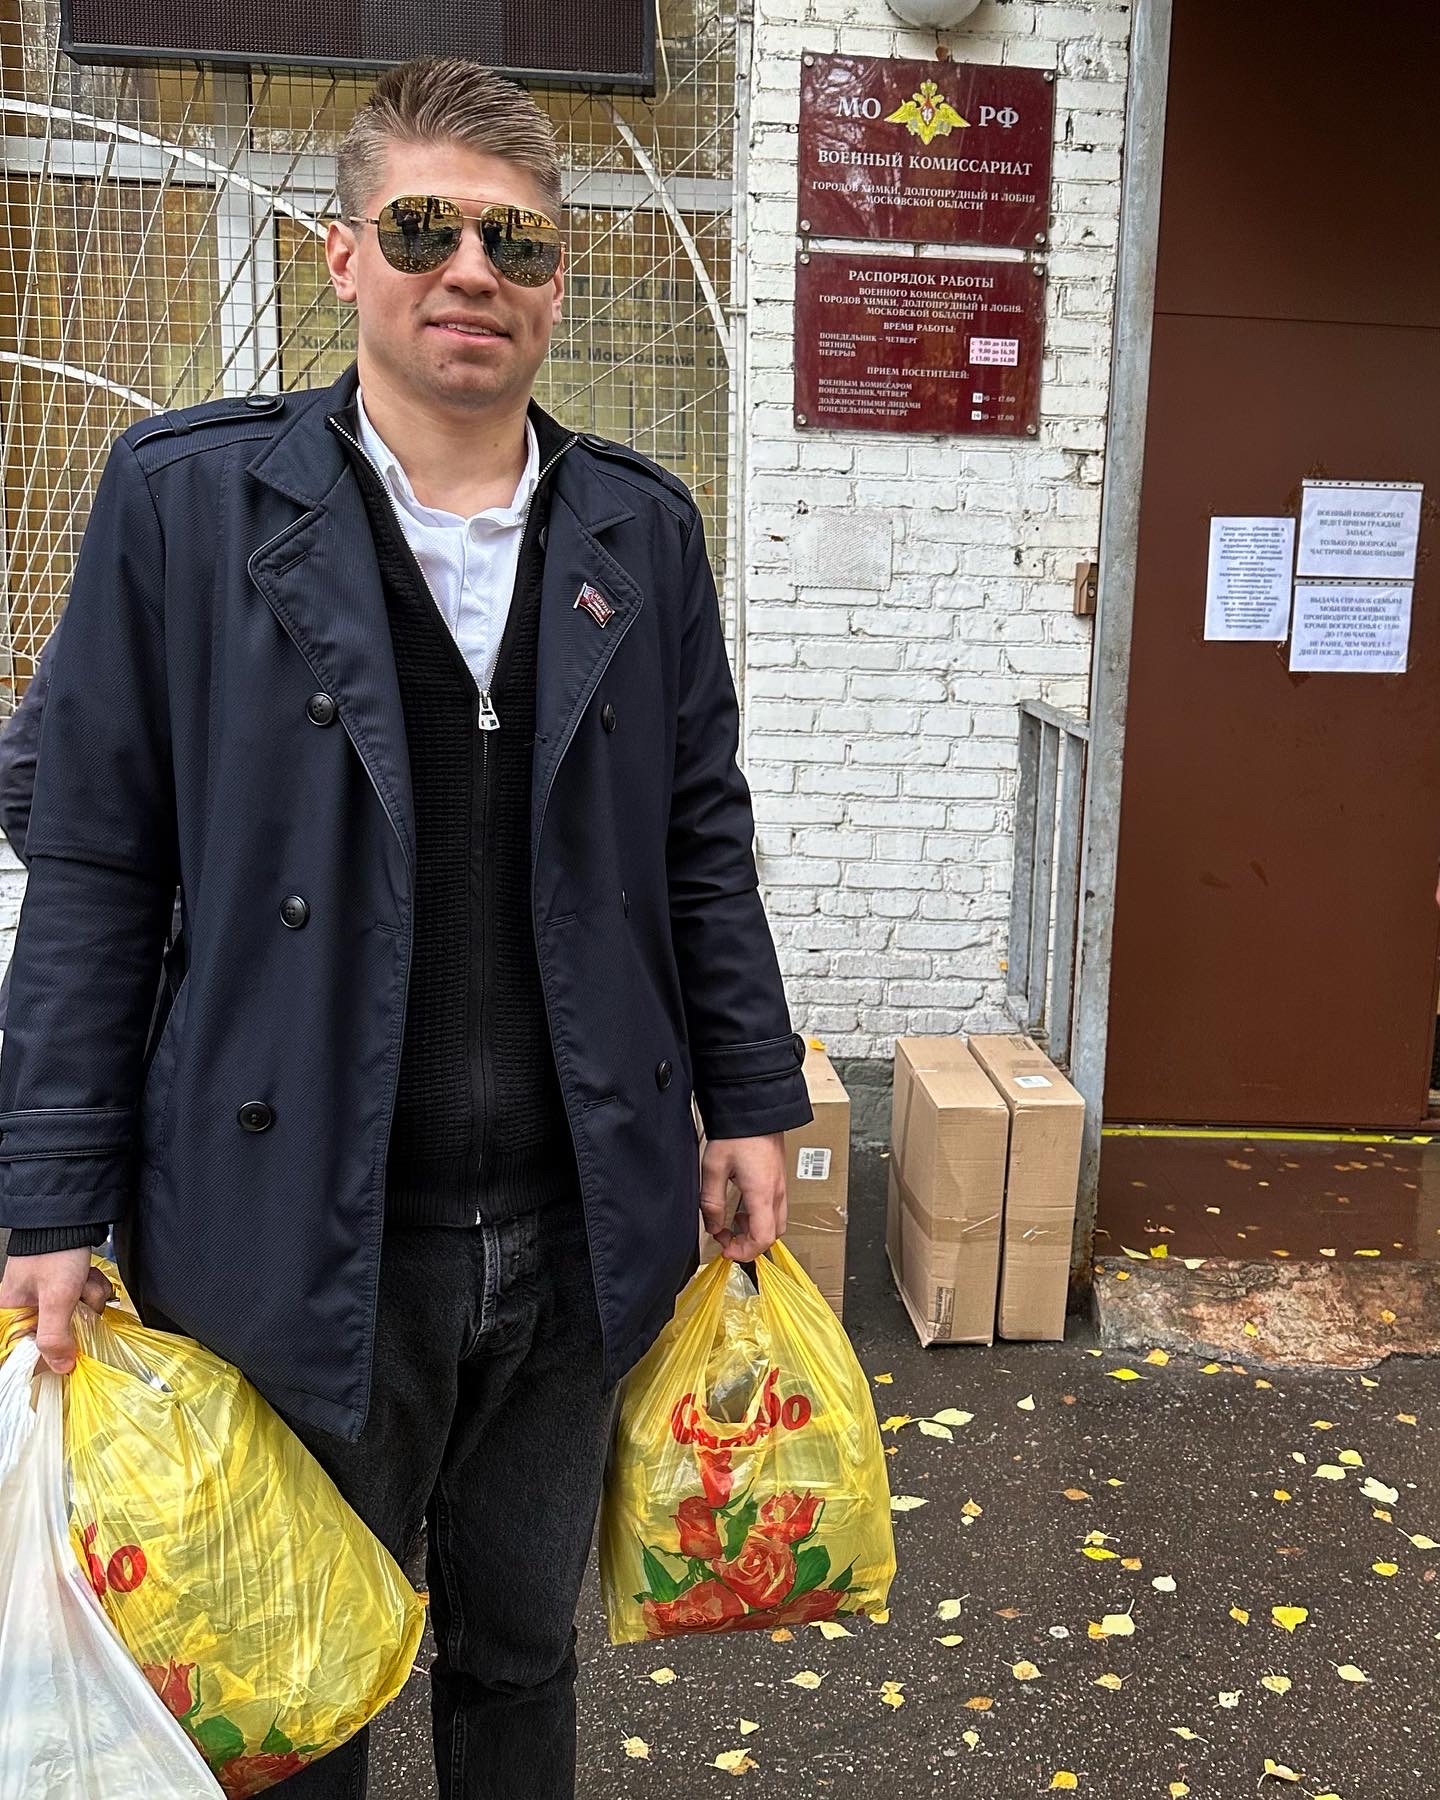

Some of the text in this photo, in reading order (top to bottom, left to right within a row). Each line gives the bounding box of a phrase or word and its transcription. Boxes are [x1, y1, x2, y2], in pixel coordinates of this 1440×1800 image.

[836, 96, 1019, 128] МО РФ
[818, 149, 1032, 176] ВОЕННЫЙ КОМИССАРИАТ
[813, 181, 858, 192] ГОРОДОВ
[904, 186, 988, 200] ДОЛГОПРУДНЫЙ
[991, 192, 998, 201] И
[1001, 193, 1035, 203] ЛОБНЯ
[865, 195, 984, 210] МОСКОВСКОЙ ОБЛАСТИ
[848, 270, 994, 288] РАСПОРЯДОК РАБОТЫ
[859, 287, 983, 302] ВОЕННОГО КОМИССАРИАТА
[819, 295, 861, 304] ГОРОДОВ
[901, 299, 978, 312] ДОЛГОПРУДНЫЙ
[866, 307, 974, 320] МОСКОВСКОЙ ОБЛАСТИ
[883, 322, 957, 333] ВРЕМЯ РАБОТЫ:
[819, 332, 877, 342] ПОНЕДЕЛЬНИК
[885, 336, 919, 344] ЧЕТВЕРГ
[819, 341, 856, 349] ПЯТНИЦА
[818, 349, 856, 357] ПЕРЕРЫВ
[867, 367, 899, 376] ПРИЕМ
[819, 379, 912, 390] ВОЕННЫМ КОМИССАРОМ
[818, 397, 921, 409] ДОЛЖНОСТНЫМИ ЛИЦАМИ
